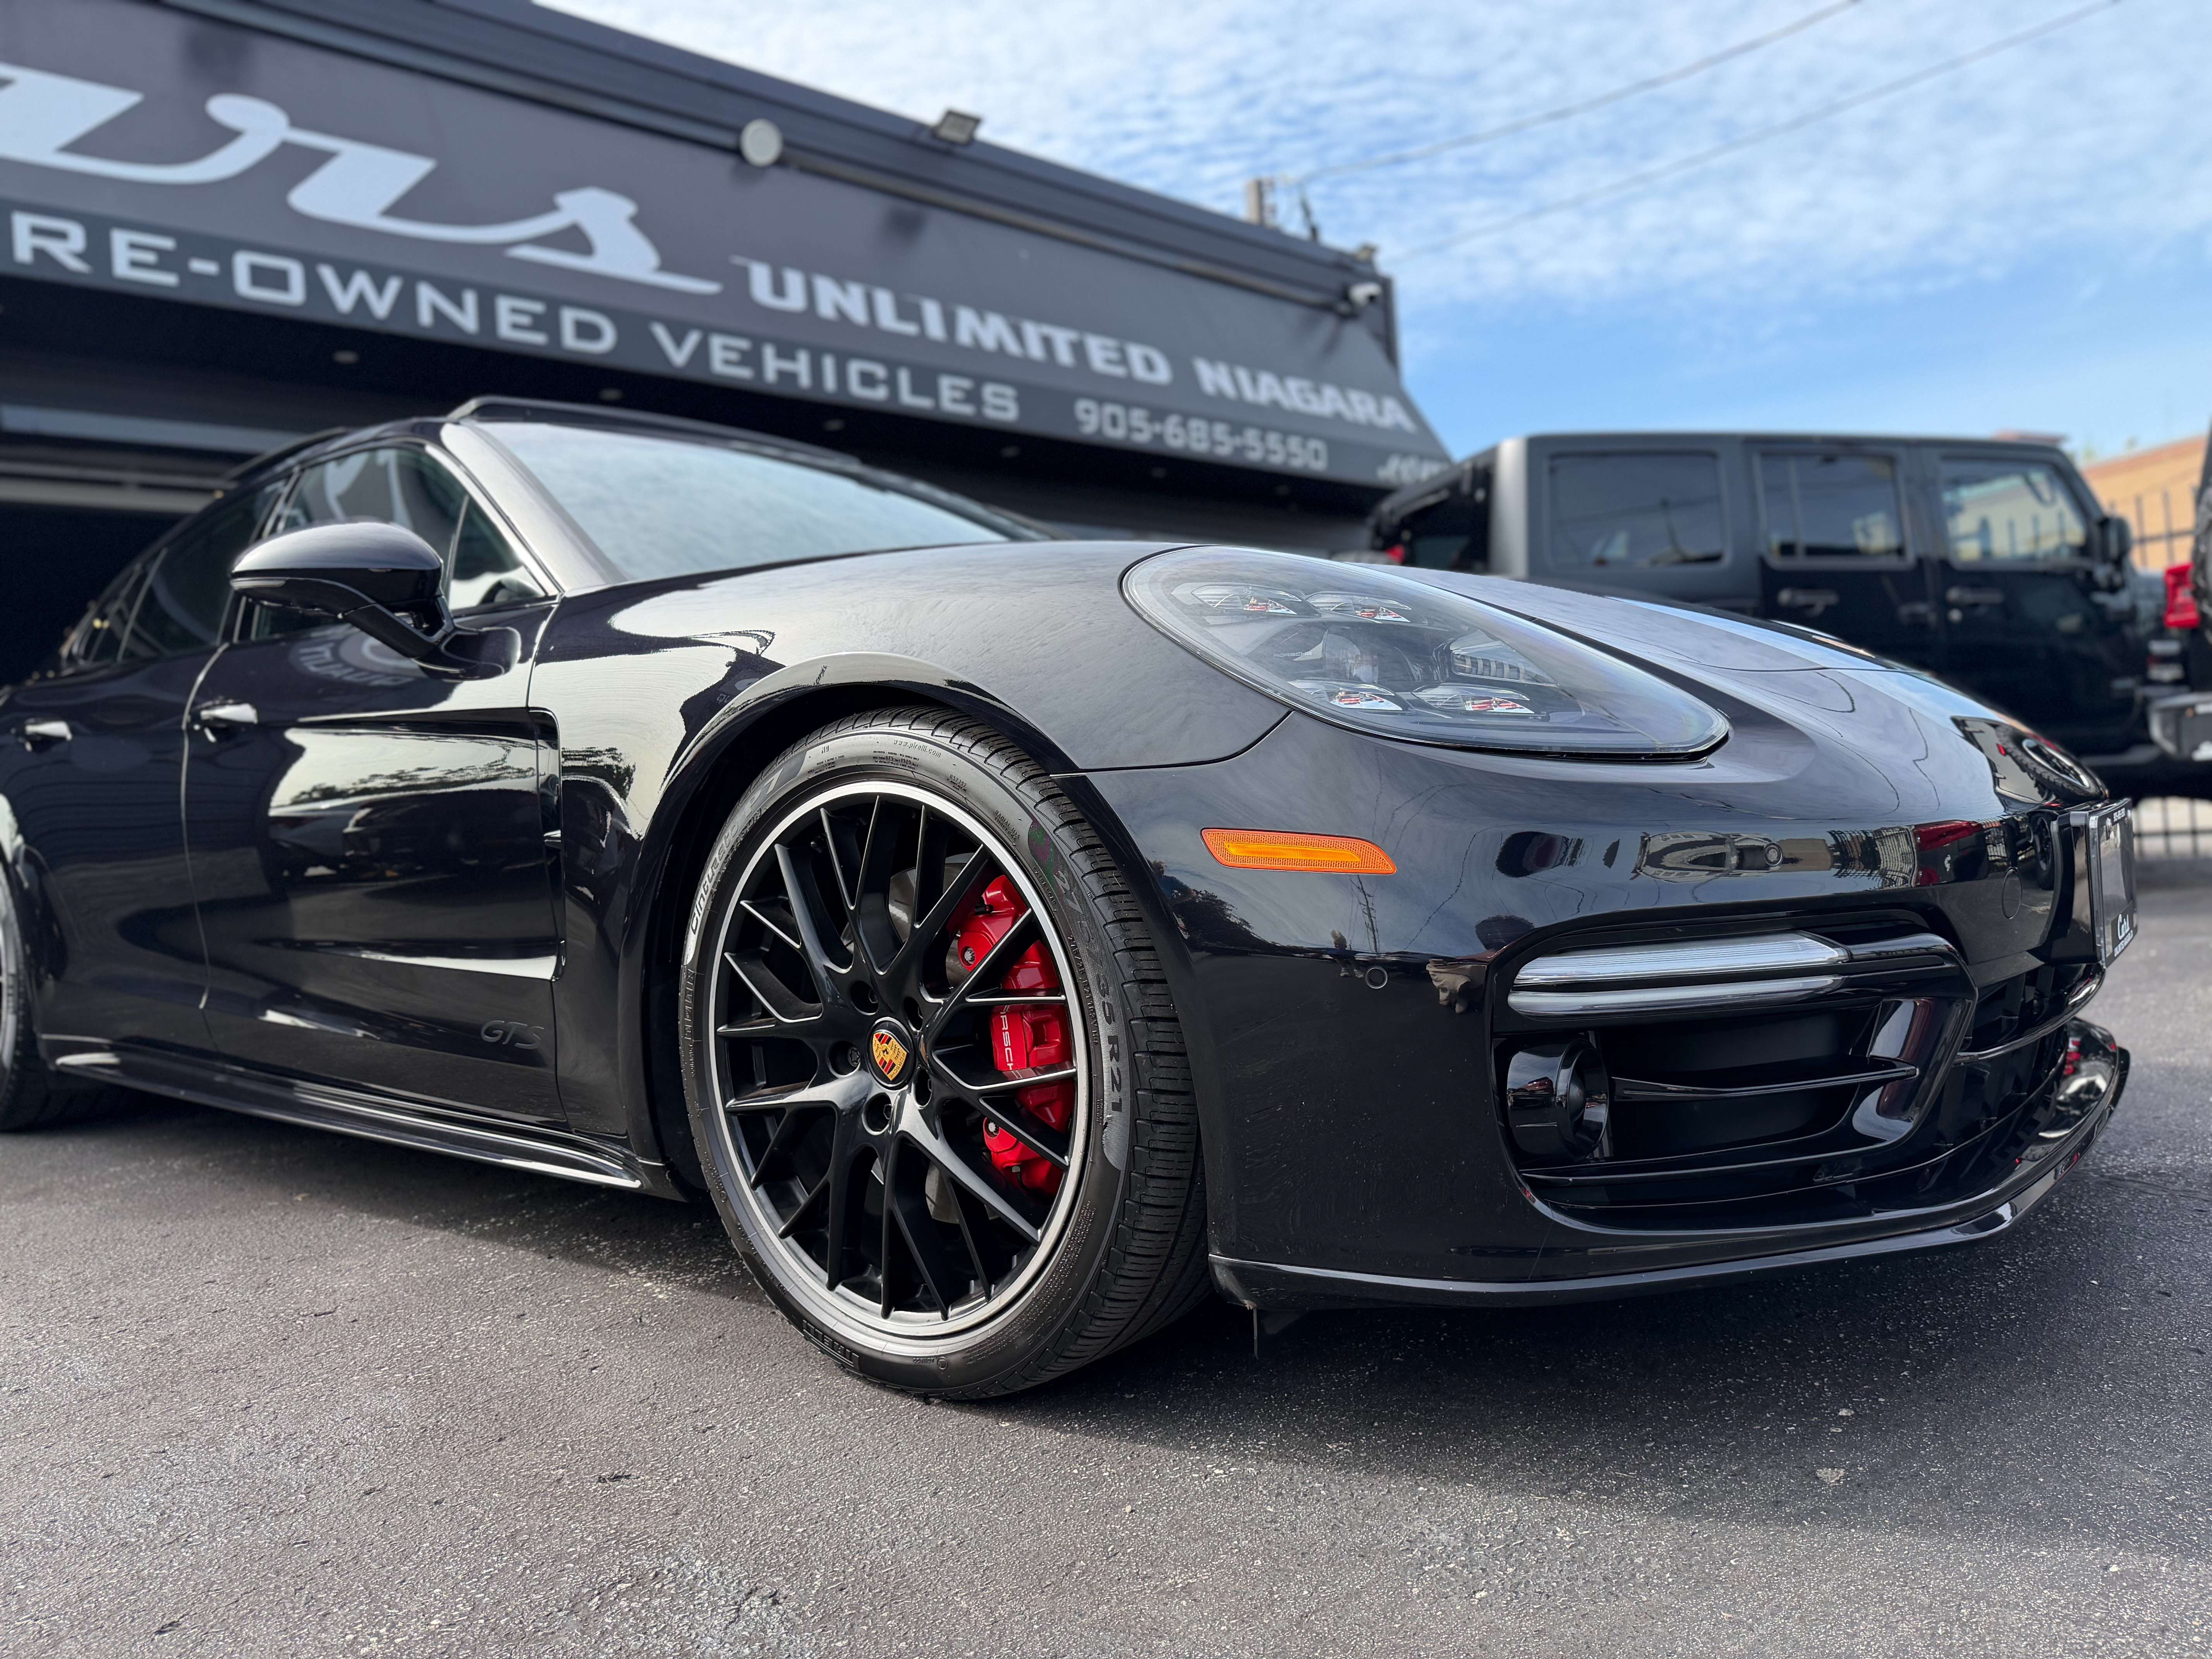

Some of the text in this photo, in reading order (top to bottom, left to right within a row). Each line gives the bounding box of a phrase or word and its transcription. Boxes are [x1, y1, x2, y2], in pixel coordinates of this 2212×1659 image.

[12, 211, 1020, 424] RE-OWNED VEHICLES
[730, 254, 1417, 434] UNLIMITED NIAGARA
[1074, 398, 1329, 472] 905-685-5550
[893, 738, 942, 759] www.pirelli.com
[744, 768, 784, 819] P7
[1053, 870, 1122, 1112] 275/35 R21
[481, 1020, 544, 1049] GTS
[890, 1052, 906, 1079] PORSCHE
